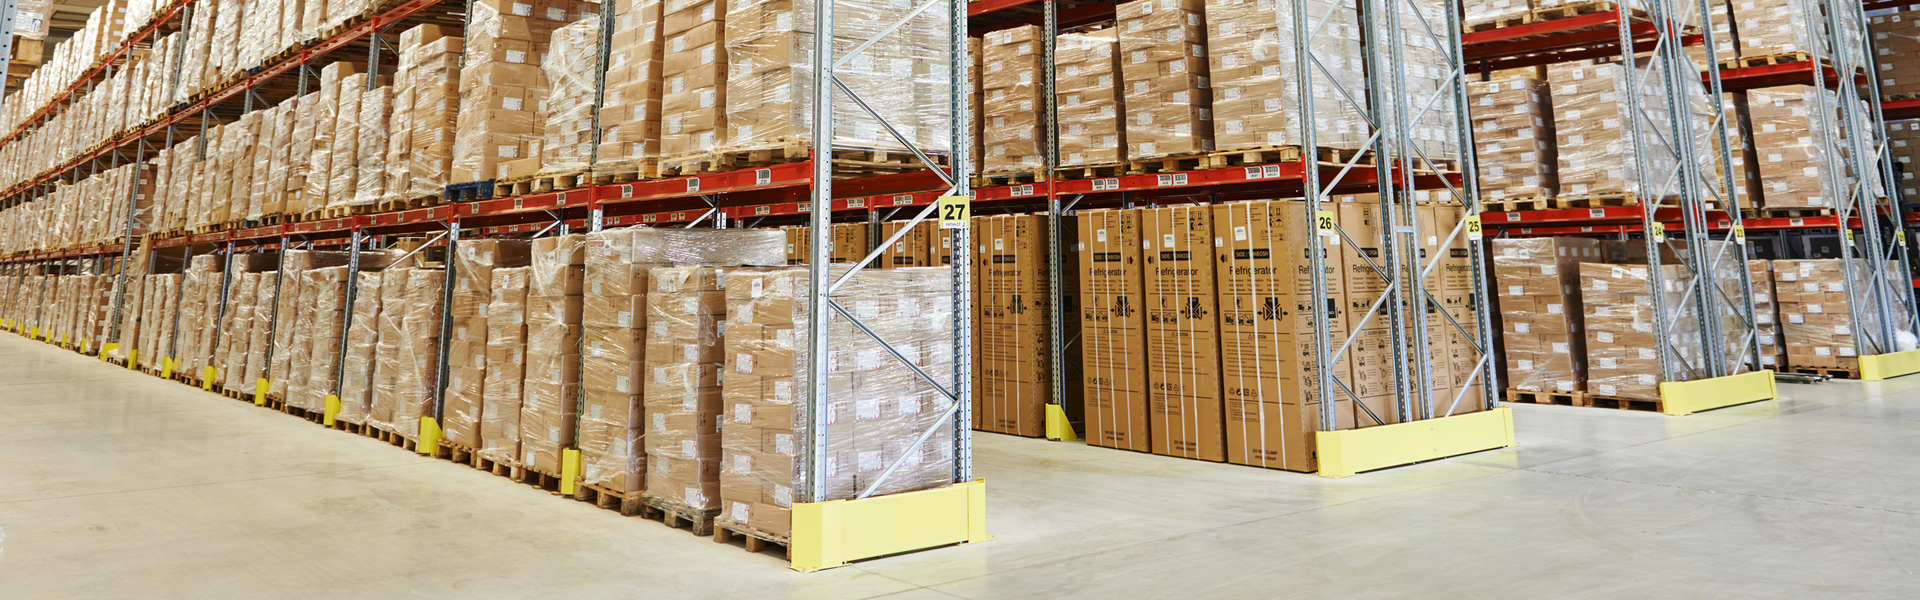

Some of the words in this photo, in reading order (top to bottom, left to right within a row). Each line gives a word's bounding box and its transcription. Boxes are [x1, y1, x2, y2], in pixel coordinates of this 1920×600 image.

[944, 204, 965, 220] 27
[1319, 216, 1332, 230] 26
[1468, 221, 1480, 232] 25
[1654, 226, 1662, 236] 24
